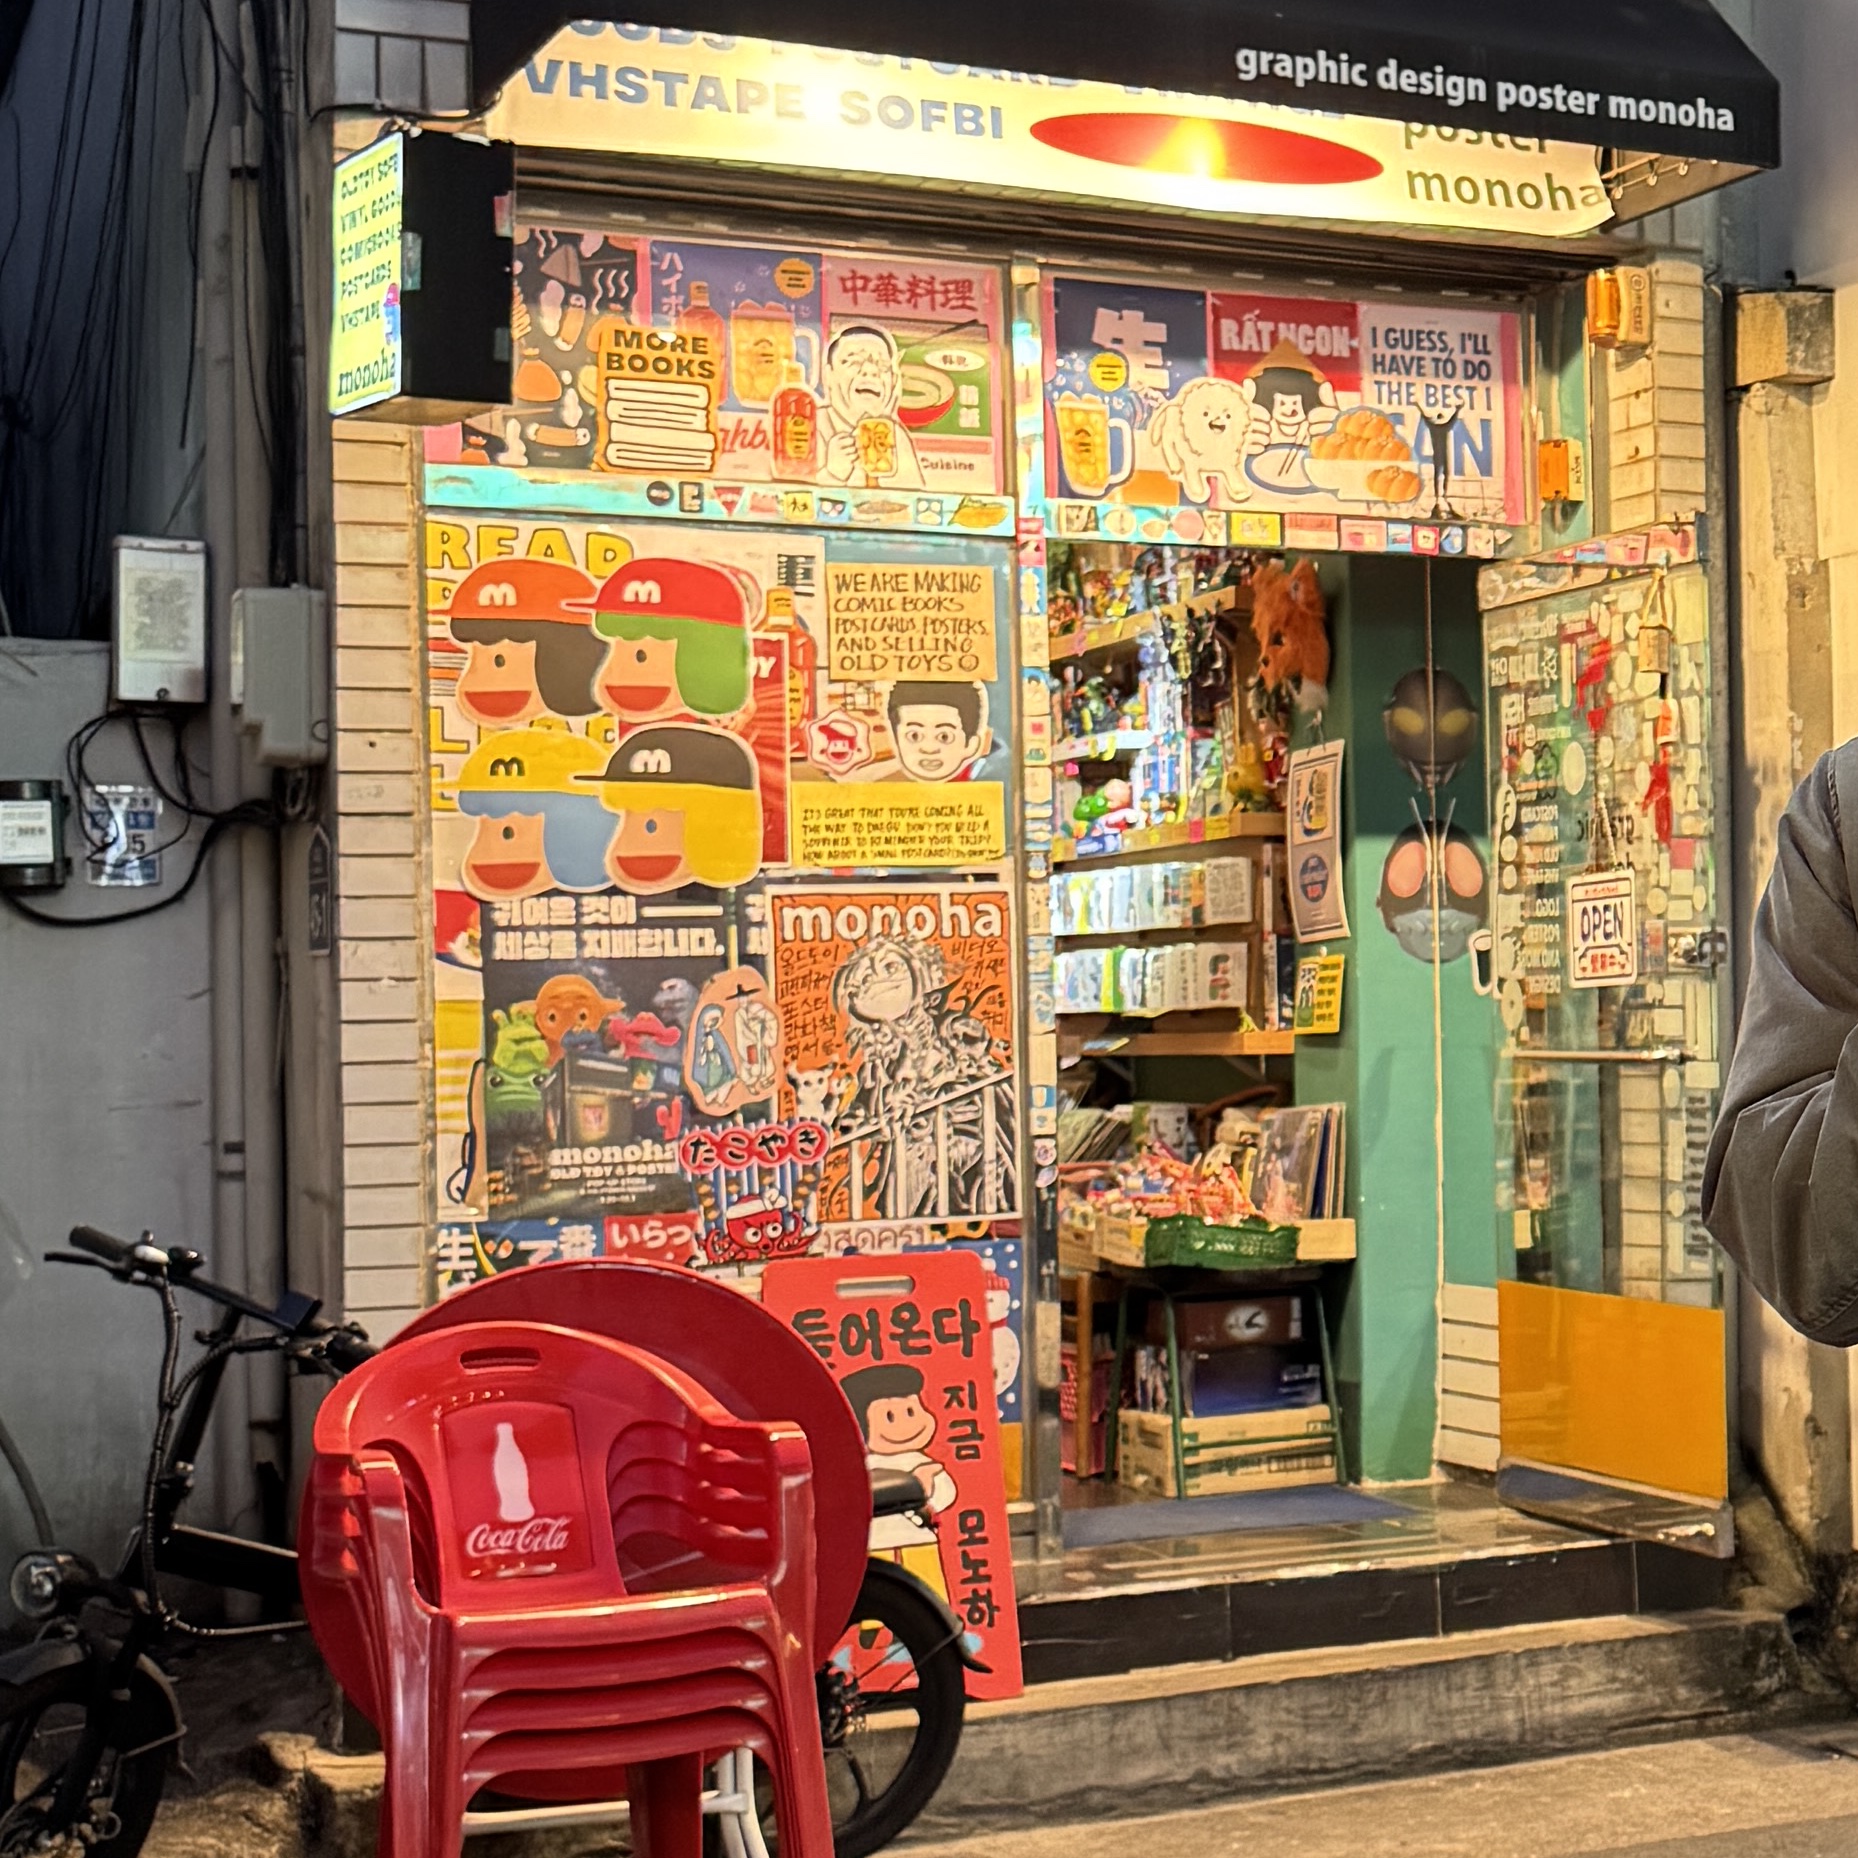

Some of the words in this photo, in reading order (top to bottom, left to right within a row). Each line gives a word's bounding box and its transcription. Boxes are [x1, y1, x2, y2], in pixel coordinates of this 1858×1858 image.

[525, 59, 806, 119] VHSTAPE
[840, 90, 1003, 139] SOFBI
[1236, 45, 1367, 88] graphic
[1377, 57, 1486, 104] design
[1497, 78, 1600, 117] poster
[1609, 93, 1734, 132] monoha
[1407, 170, 1606, 212] monoha
[839, 269, 979, 313] 中華料理
[613, 329, 710, 355] MORE
[1370, 326, 1378, 348] I
[1384, 326, 1455, 357] GUESS,
[1460, 332, 1492, 355] I'LL
[338, 346, 396, 397] monoha
[606, 353, 716, 380] BOOKS
[1372, 354, 1426, 378] HAVE
[1431, 356, 1457, 379] TO
[1463, 359, 1492, 381] DO
[1373, 380, 1418, 407] THE
[1424, 382, 1477, 411] BEST
[1386, 412, 1492, 477] AN
[426, 518, 633, 580] READ
[835, 573, 867, 594] WE
[870, 573, 910, 592] ARE
[914, 570, 982, 593] MAKING
[834, 597, 897, 613] COMIC
[902, 596, 965, 613] BOOKS
[836, 636, 877, 653] AND
[882, 636, 973, 653] SELLING
[840, 654, 889, 673] OLD
[894, 654, 953, 672] TOYS
[967, 804, 985, 817] ALL
[782, 903, 1003, 942] monoha
[1580, 901, 1624, 943] OPEN
[550, 1139, 678, 1166] monoha
[691, 1127, 823, 1166] たこやき
[550, 1167, 582, 1181] OLD
[582, 1165, 614, 1178] TOY
